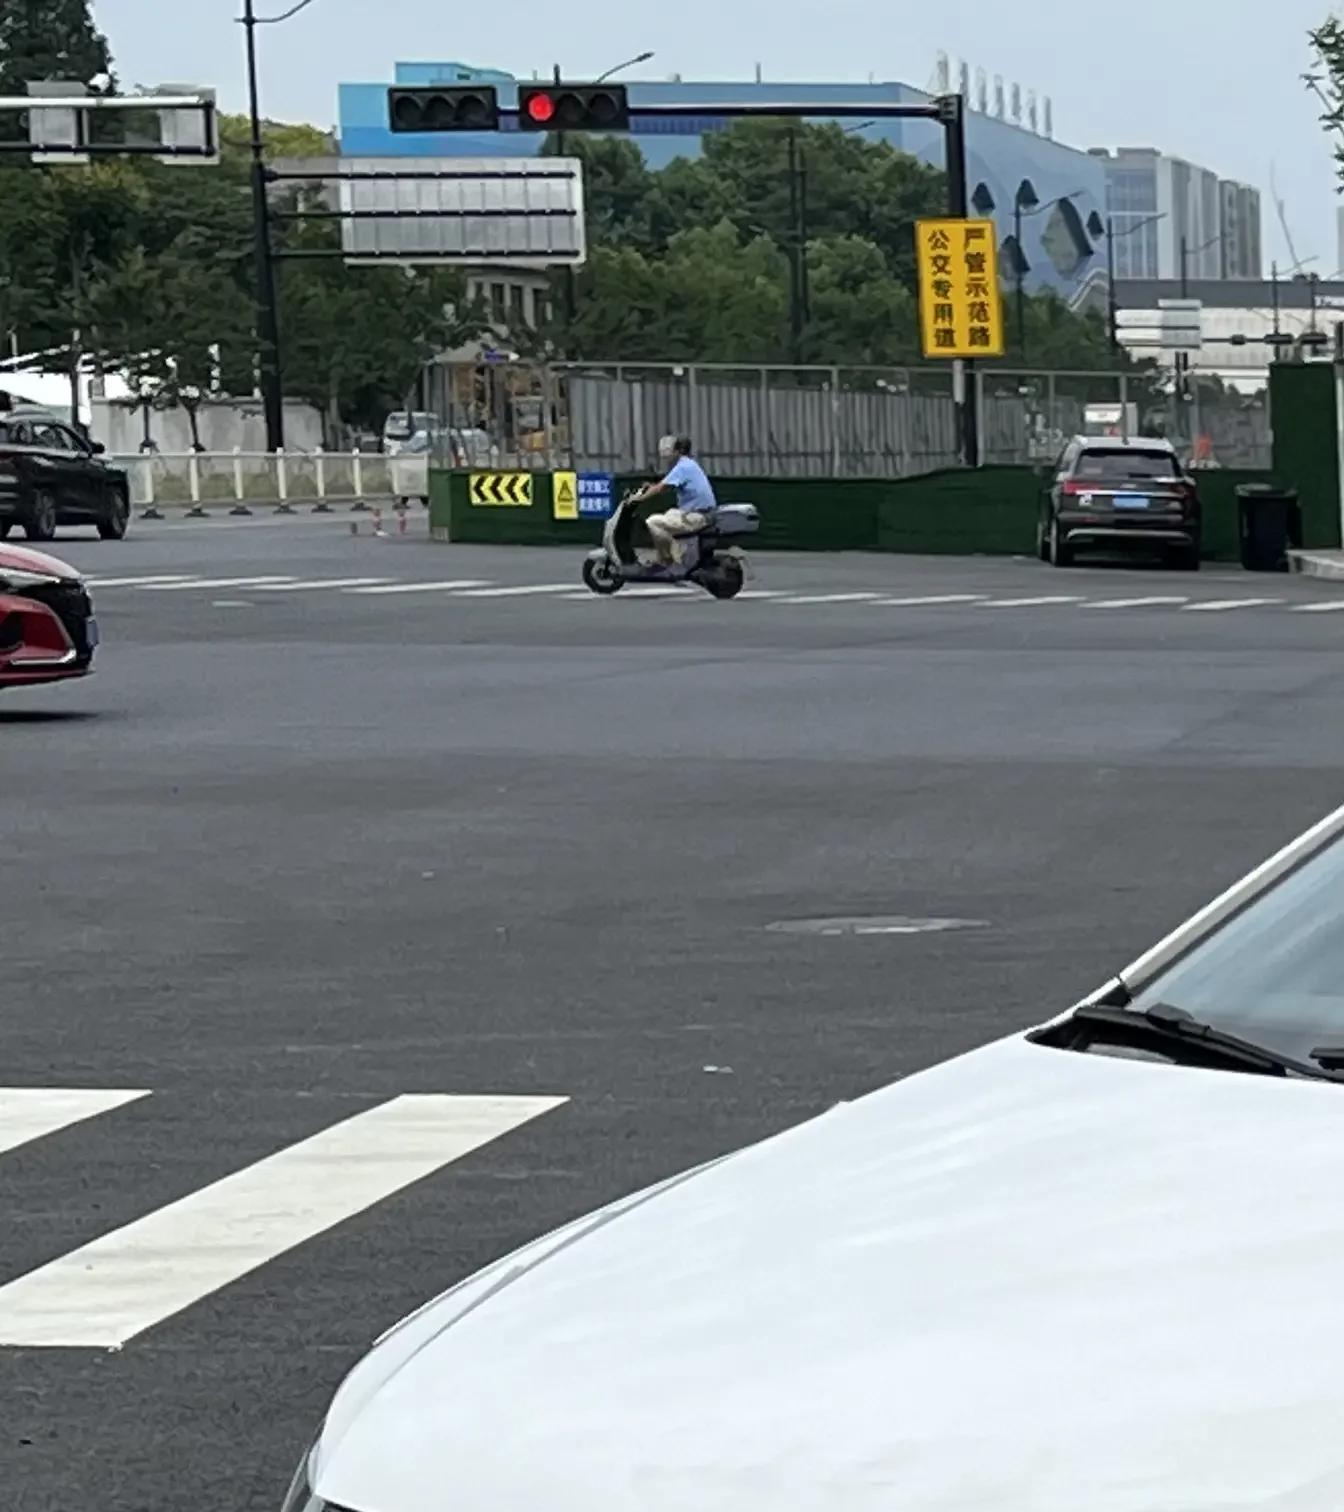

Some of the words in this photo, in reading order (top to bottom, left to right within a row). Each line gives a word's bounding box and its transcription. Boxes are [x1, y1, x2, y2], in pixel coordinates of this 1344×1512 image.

[927, 229, 957, 348] 公交专用道
[963, 227, 991, 347] 严管示范路
